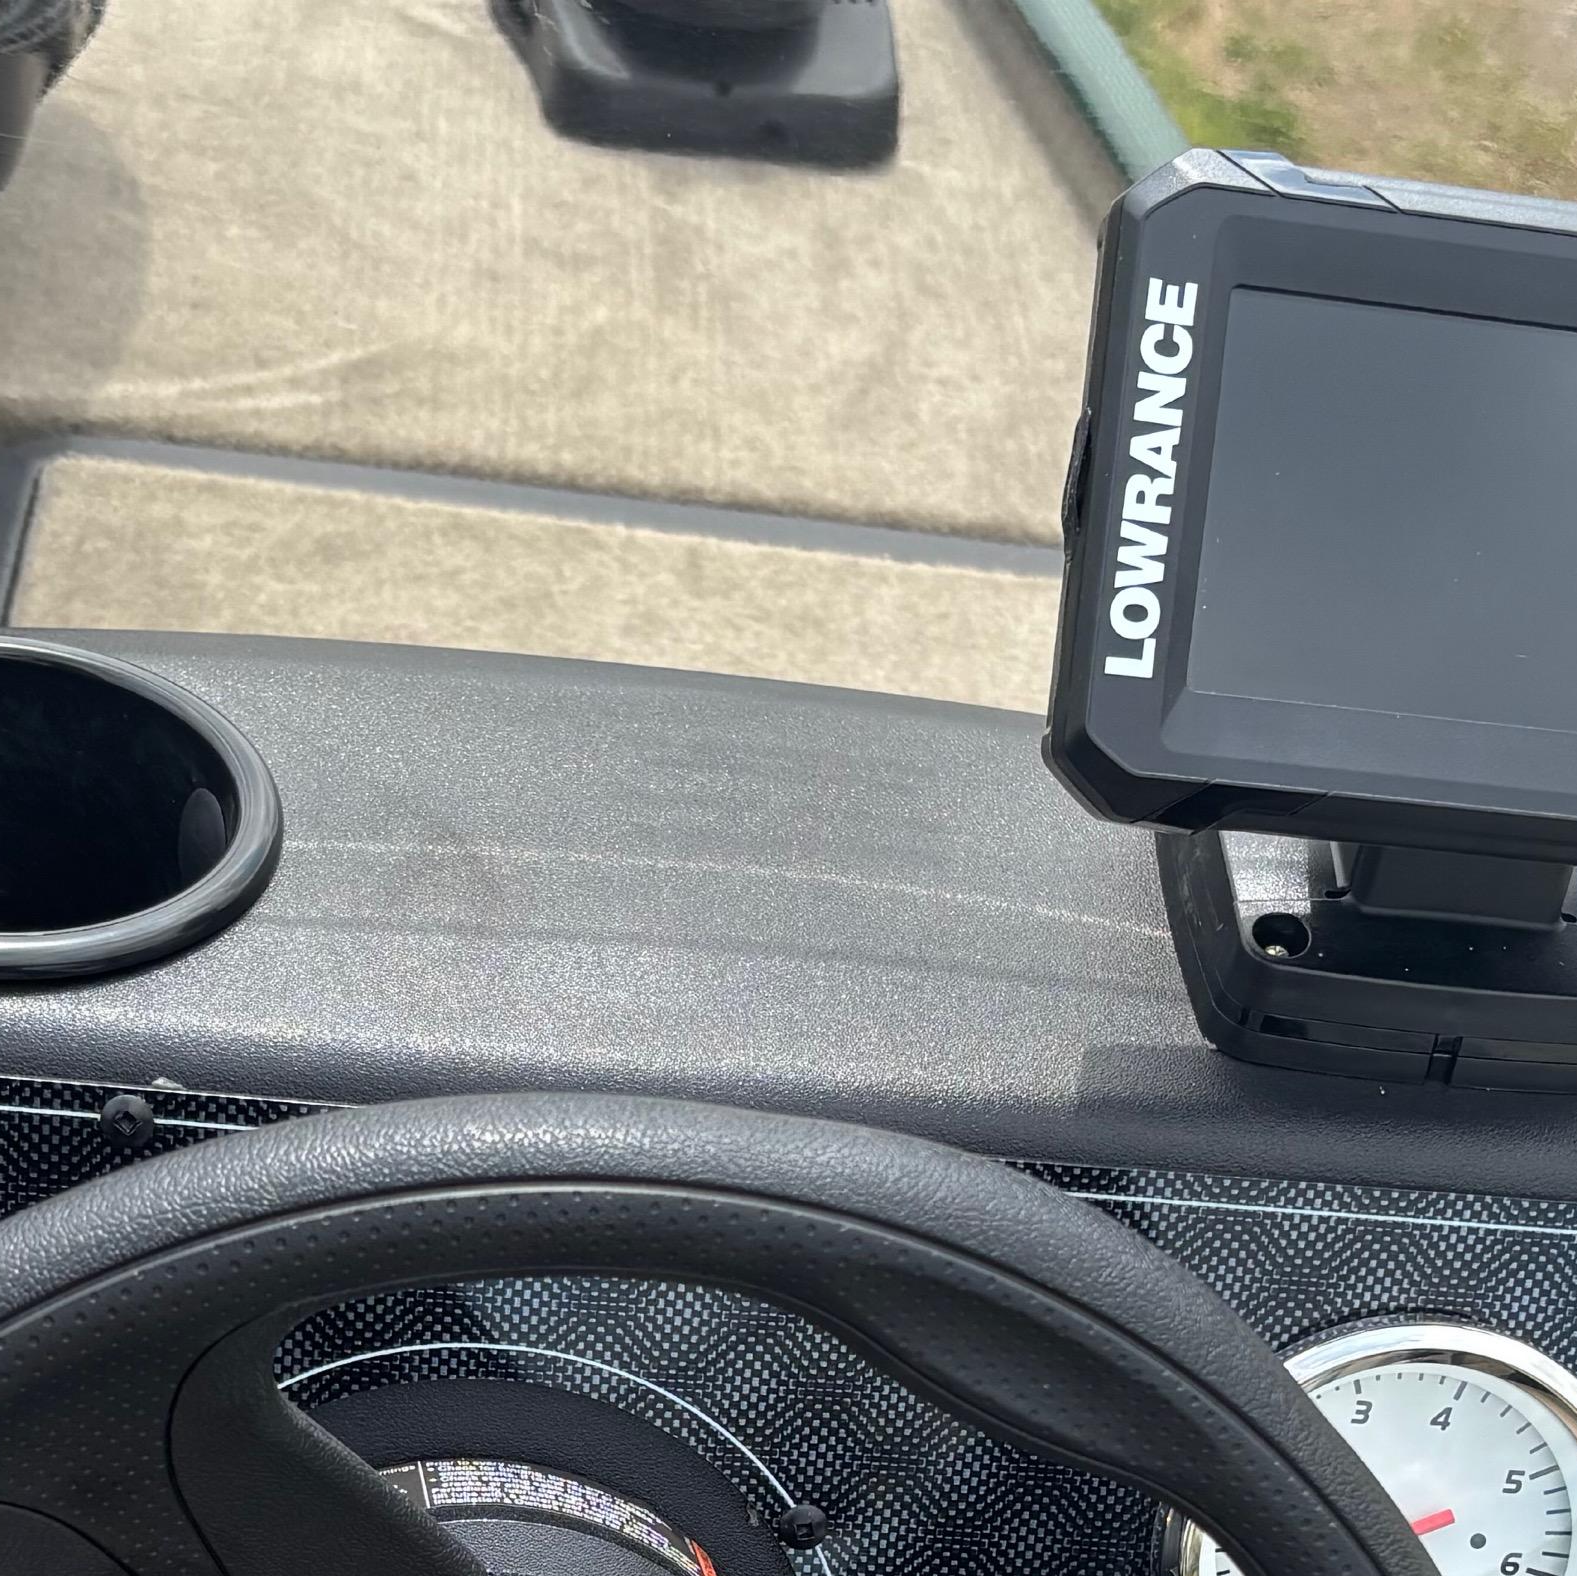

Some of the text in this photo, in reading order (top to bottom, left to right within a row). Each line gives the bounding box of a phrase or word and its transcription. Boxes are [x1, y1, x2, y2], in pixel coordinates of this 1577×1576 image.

[1103, 276, 1199, 679] LOWRANCE
[1350, 1400, 1373, 1425] 3
[1429, 1406, 1453, 1431] 4
[378, 1465, 416, 1476] rnings
[1502, 1470, 1525, 1494] 5
[1500, 1552, 1523, 1576] 6
